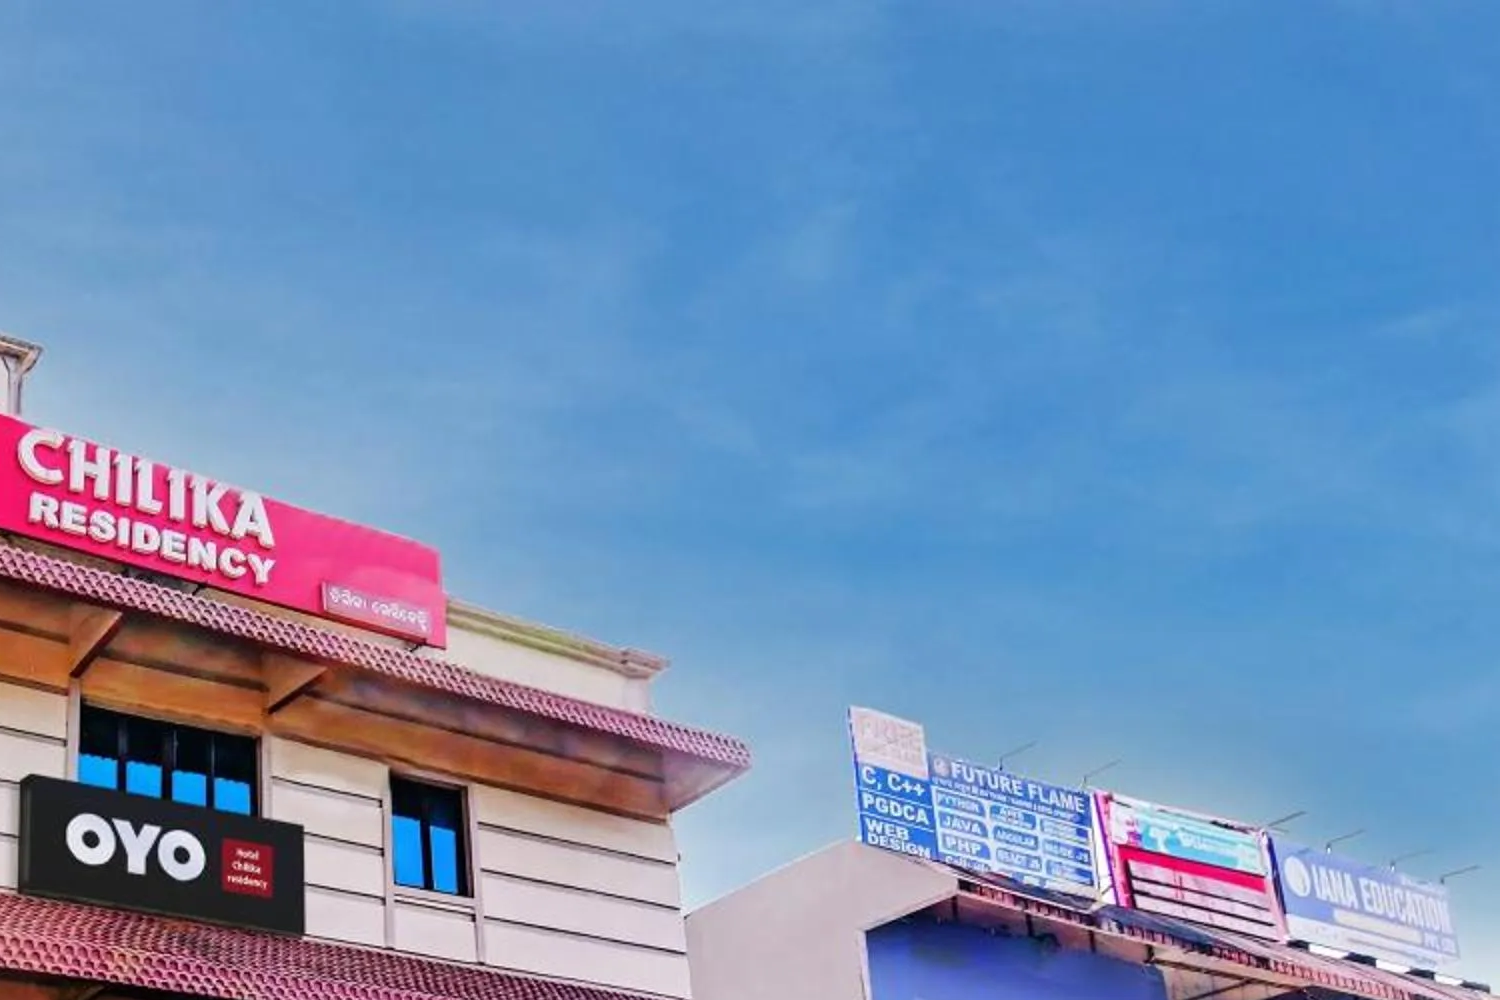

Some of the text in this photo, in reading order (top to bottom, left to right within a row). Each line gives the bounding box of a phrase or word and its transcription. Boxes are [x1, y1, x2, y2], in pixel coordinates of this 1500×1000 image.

[18, 430, 276, 548] CHILIKA
[28, 491, 276, 585] RESIDENCY
[888, 774, 925, 796] C++
[951, 761, 1085, 813] FUTURE FLAME
[862, 792, 929, 825] PGDCA
[866, 818, 909, 840] WEB
[943, 818, 981, 835] JAVA
[65, 813, 206, 881] OYO
[868, 833, 931, 858] DESIGN
[946, 837, 981, 854] PHP
[1358, 877, 1453, 934] EDUCATION
